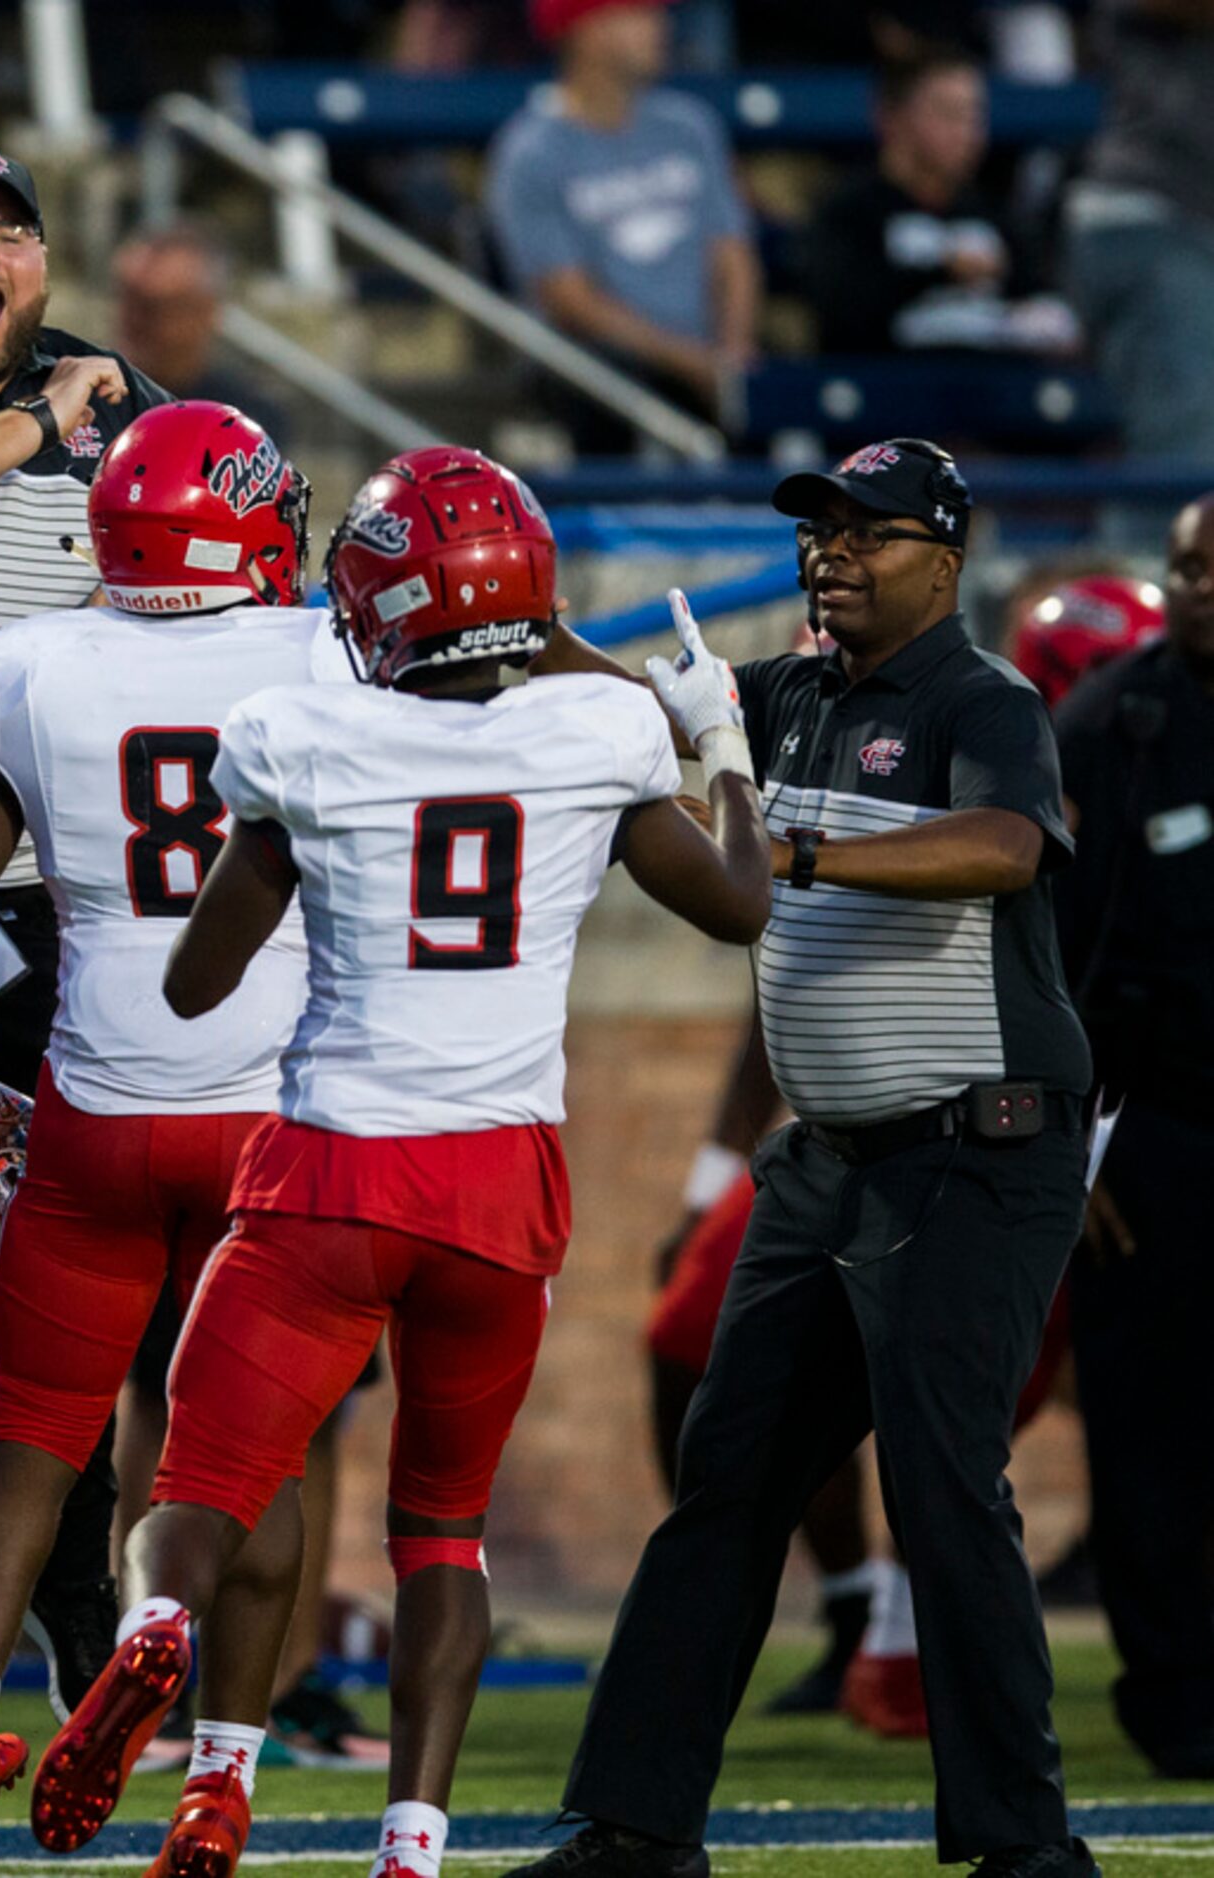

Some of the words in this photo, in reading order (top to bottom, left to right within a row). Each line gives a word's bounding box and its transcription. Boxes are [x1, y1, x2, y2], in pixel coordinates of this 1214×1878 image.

[128, 483, 143, 503] 8
[110, 589, 203, 611] Riddell
[458, 582, 476, 607] 9
[458, 620, 531, 650] schutt
[118, 725, 229, 918] 8
[408, 793, 525, 970] 9
